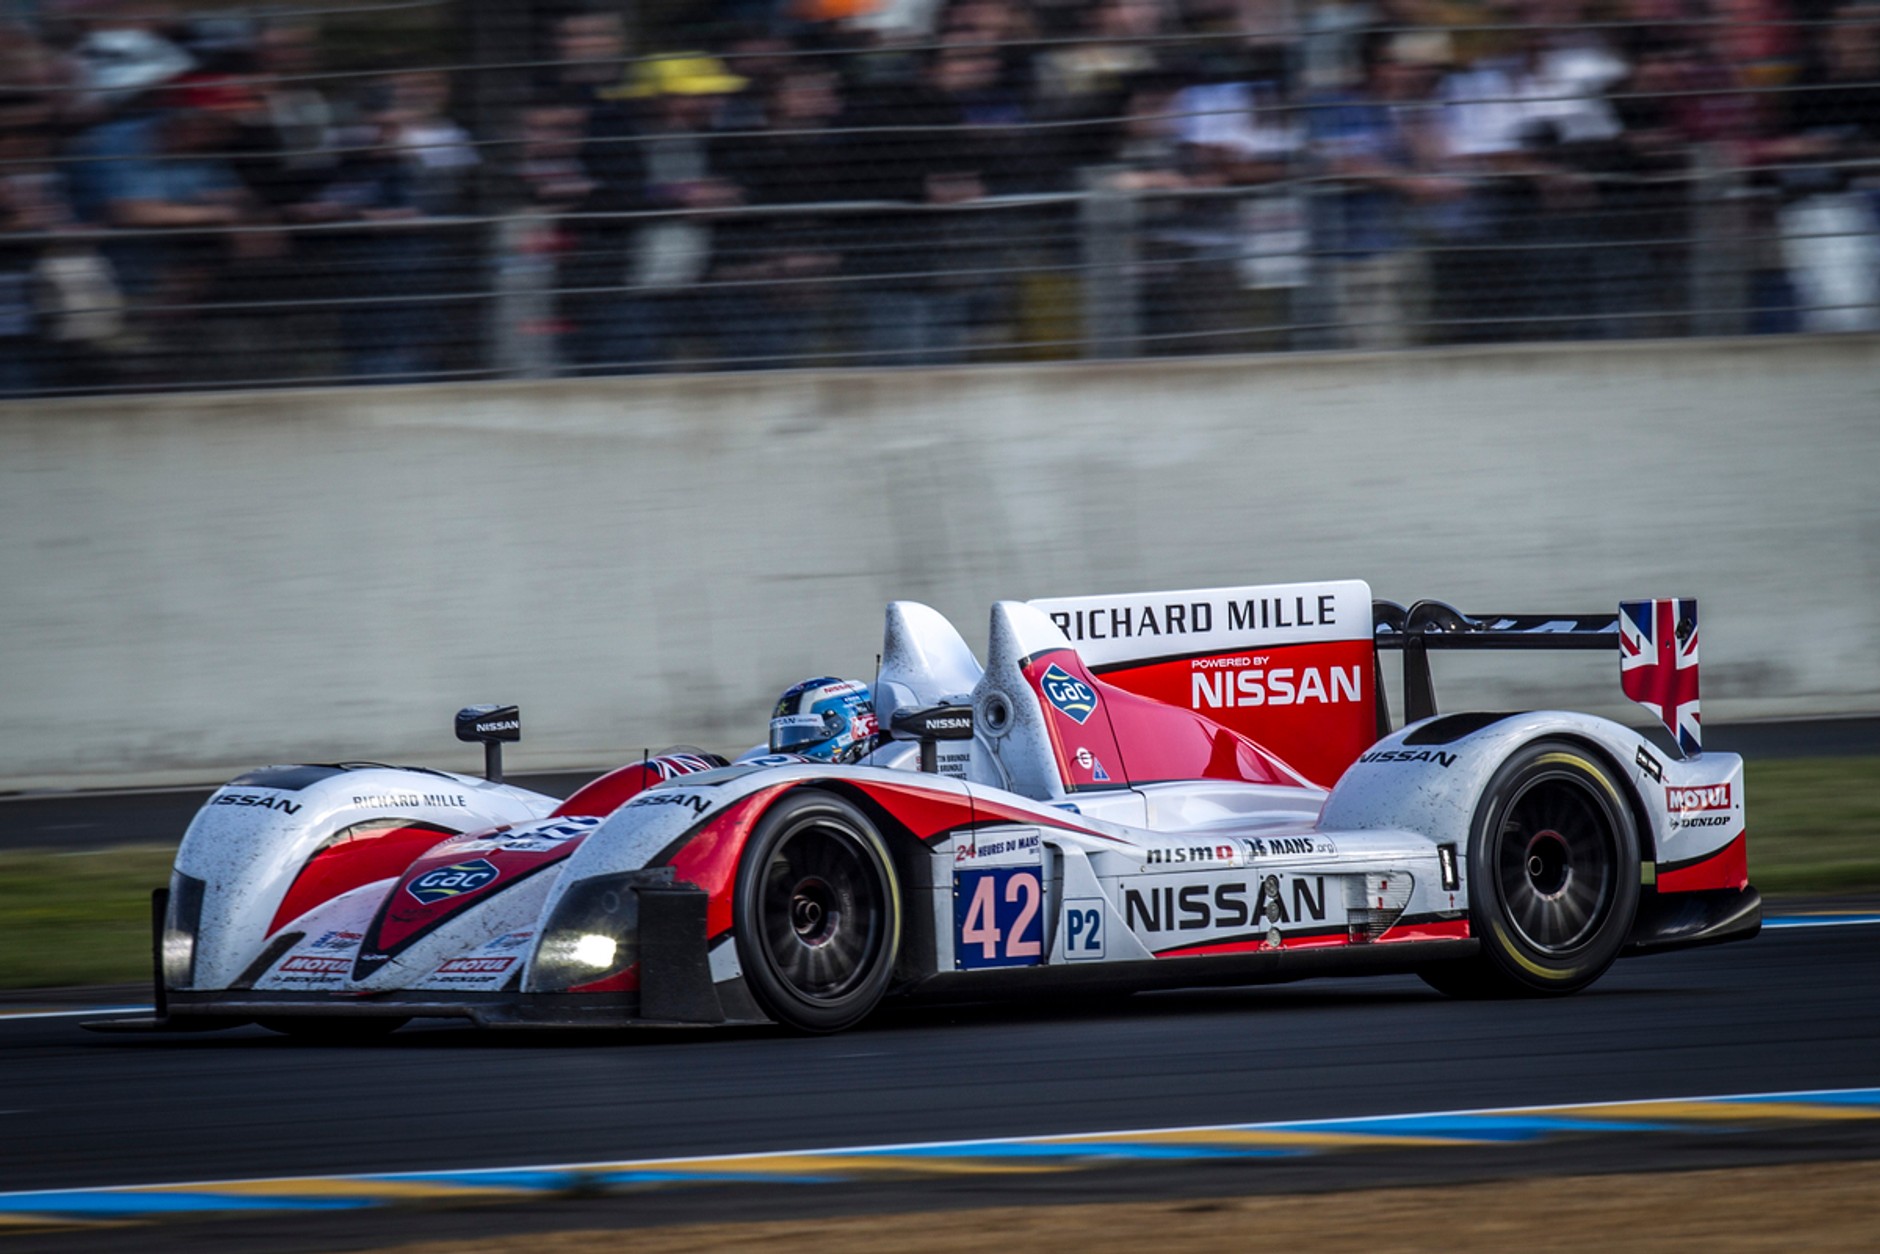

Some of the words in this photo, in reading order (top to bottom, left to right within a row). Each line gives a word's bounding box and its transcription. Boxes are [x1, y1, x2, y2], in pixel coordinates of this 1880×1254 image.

[1050, 602, 1212, 641] RICHARD
[1228, 595, 1336, 631] MILLE
[1191, 657, 1251, 669] POWERED
[1253, 656, 1270, 666] BY
[1191, 665, 1362, 709] NISSAN
[476, 719, 519, 733] NISSAN
[925, 718, 971, 729] NISSAN
[211, 794, 303, 815] ISSAN
[352, 795, 420, 809] RICHARD
[423, 794, 467, 808] MILLE
[1669, 787, 1729, 809] MOTUL
[1681, 816, 1731, 828] DUNLOP
[955, 844, 977, 861] 24
[978, 841, 1005, 857] HEURES
[1006, 839, 1017, 852] DU
[1018, 835, 1040, 850] MANS
[1125, 876, 1326, 932] NISSAN
[961, 872, 1042, 960] 42
[1067, 908, 1101, 951] P2
[440, 959, 511, 972] MOTUL
